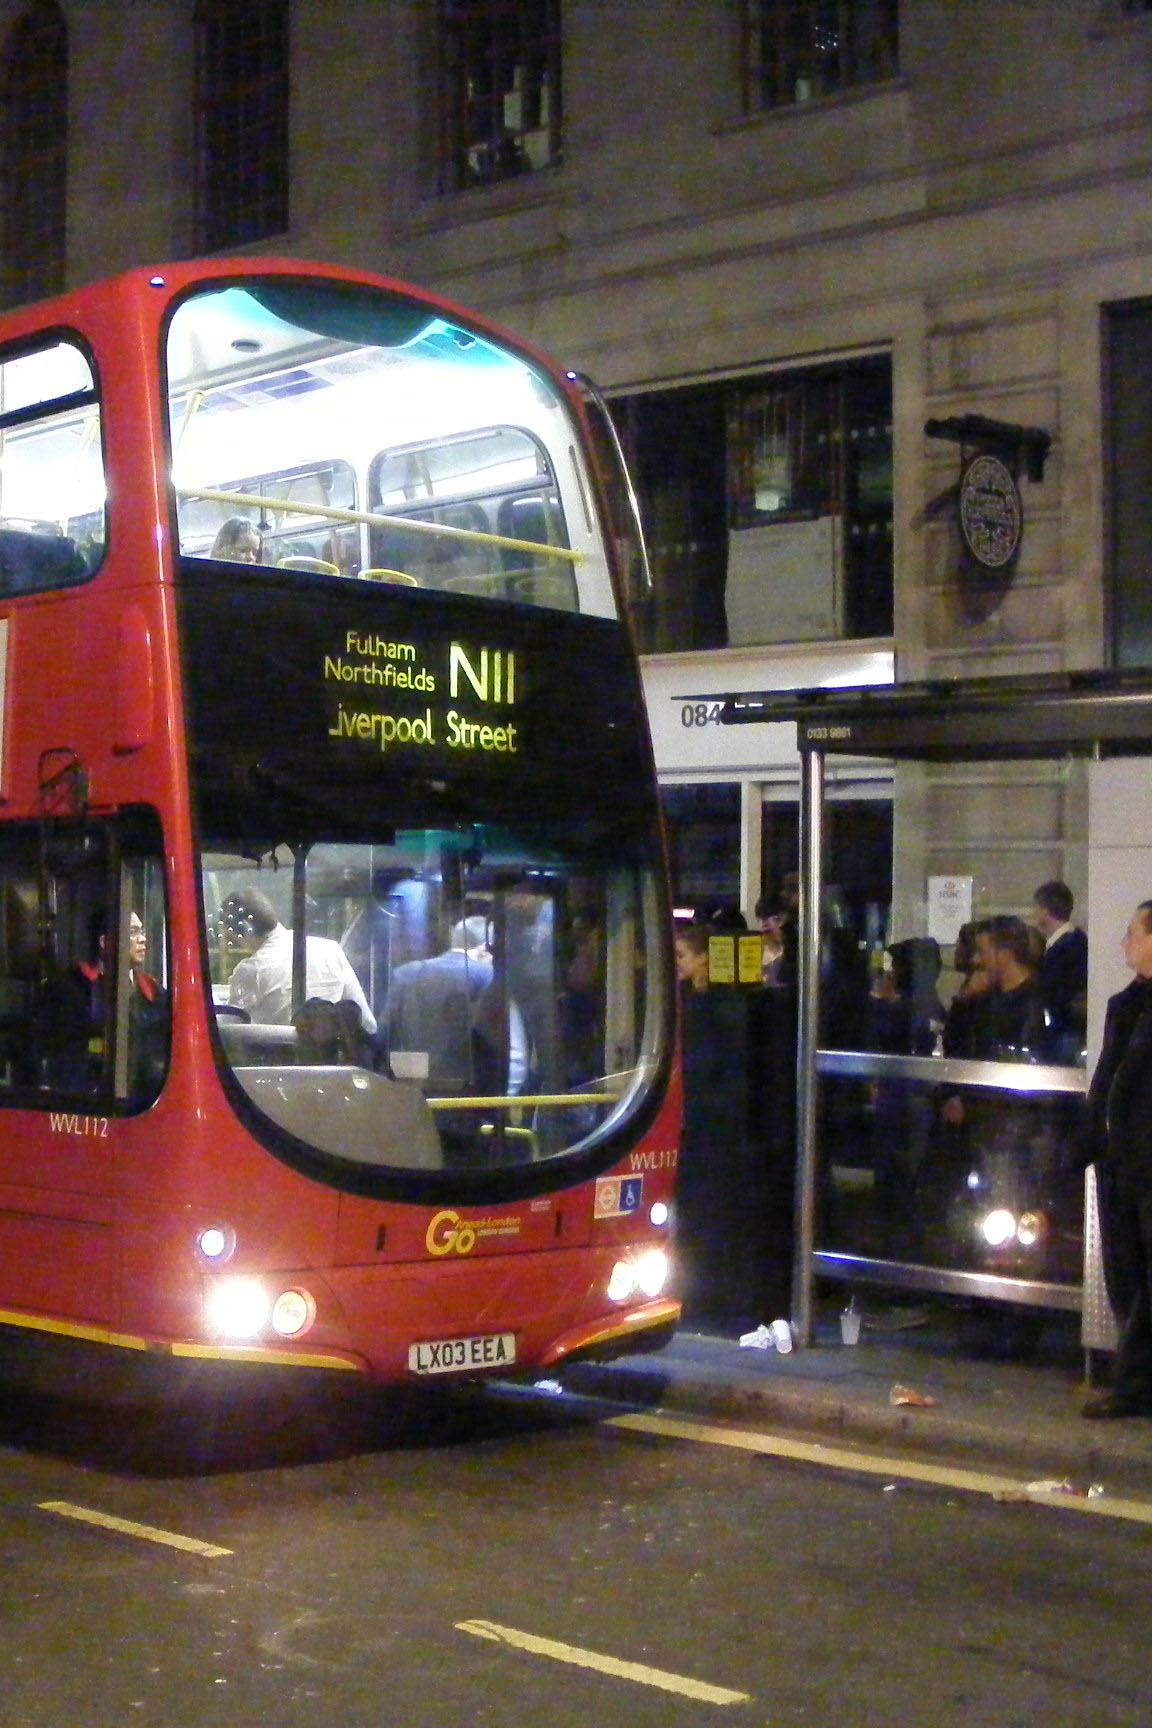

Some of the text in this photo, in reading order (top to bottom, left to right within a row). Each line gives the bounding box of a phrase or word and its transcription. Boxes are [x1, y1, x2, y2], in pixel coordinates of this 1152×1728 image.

[346, 631, 416, 662] Fulham
[324, 655, 436, 692] Northfields
[446, 709, 516, 752] Street
[49, 1112, 109, 1139] WVL112
[425, 1209, 476, 1256] Go
[416, 1337, 507, 1371] LX03 EEA
